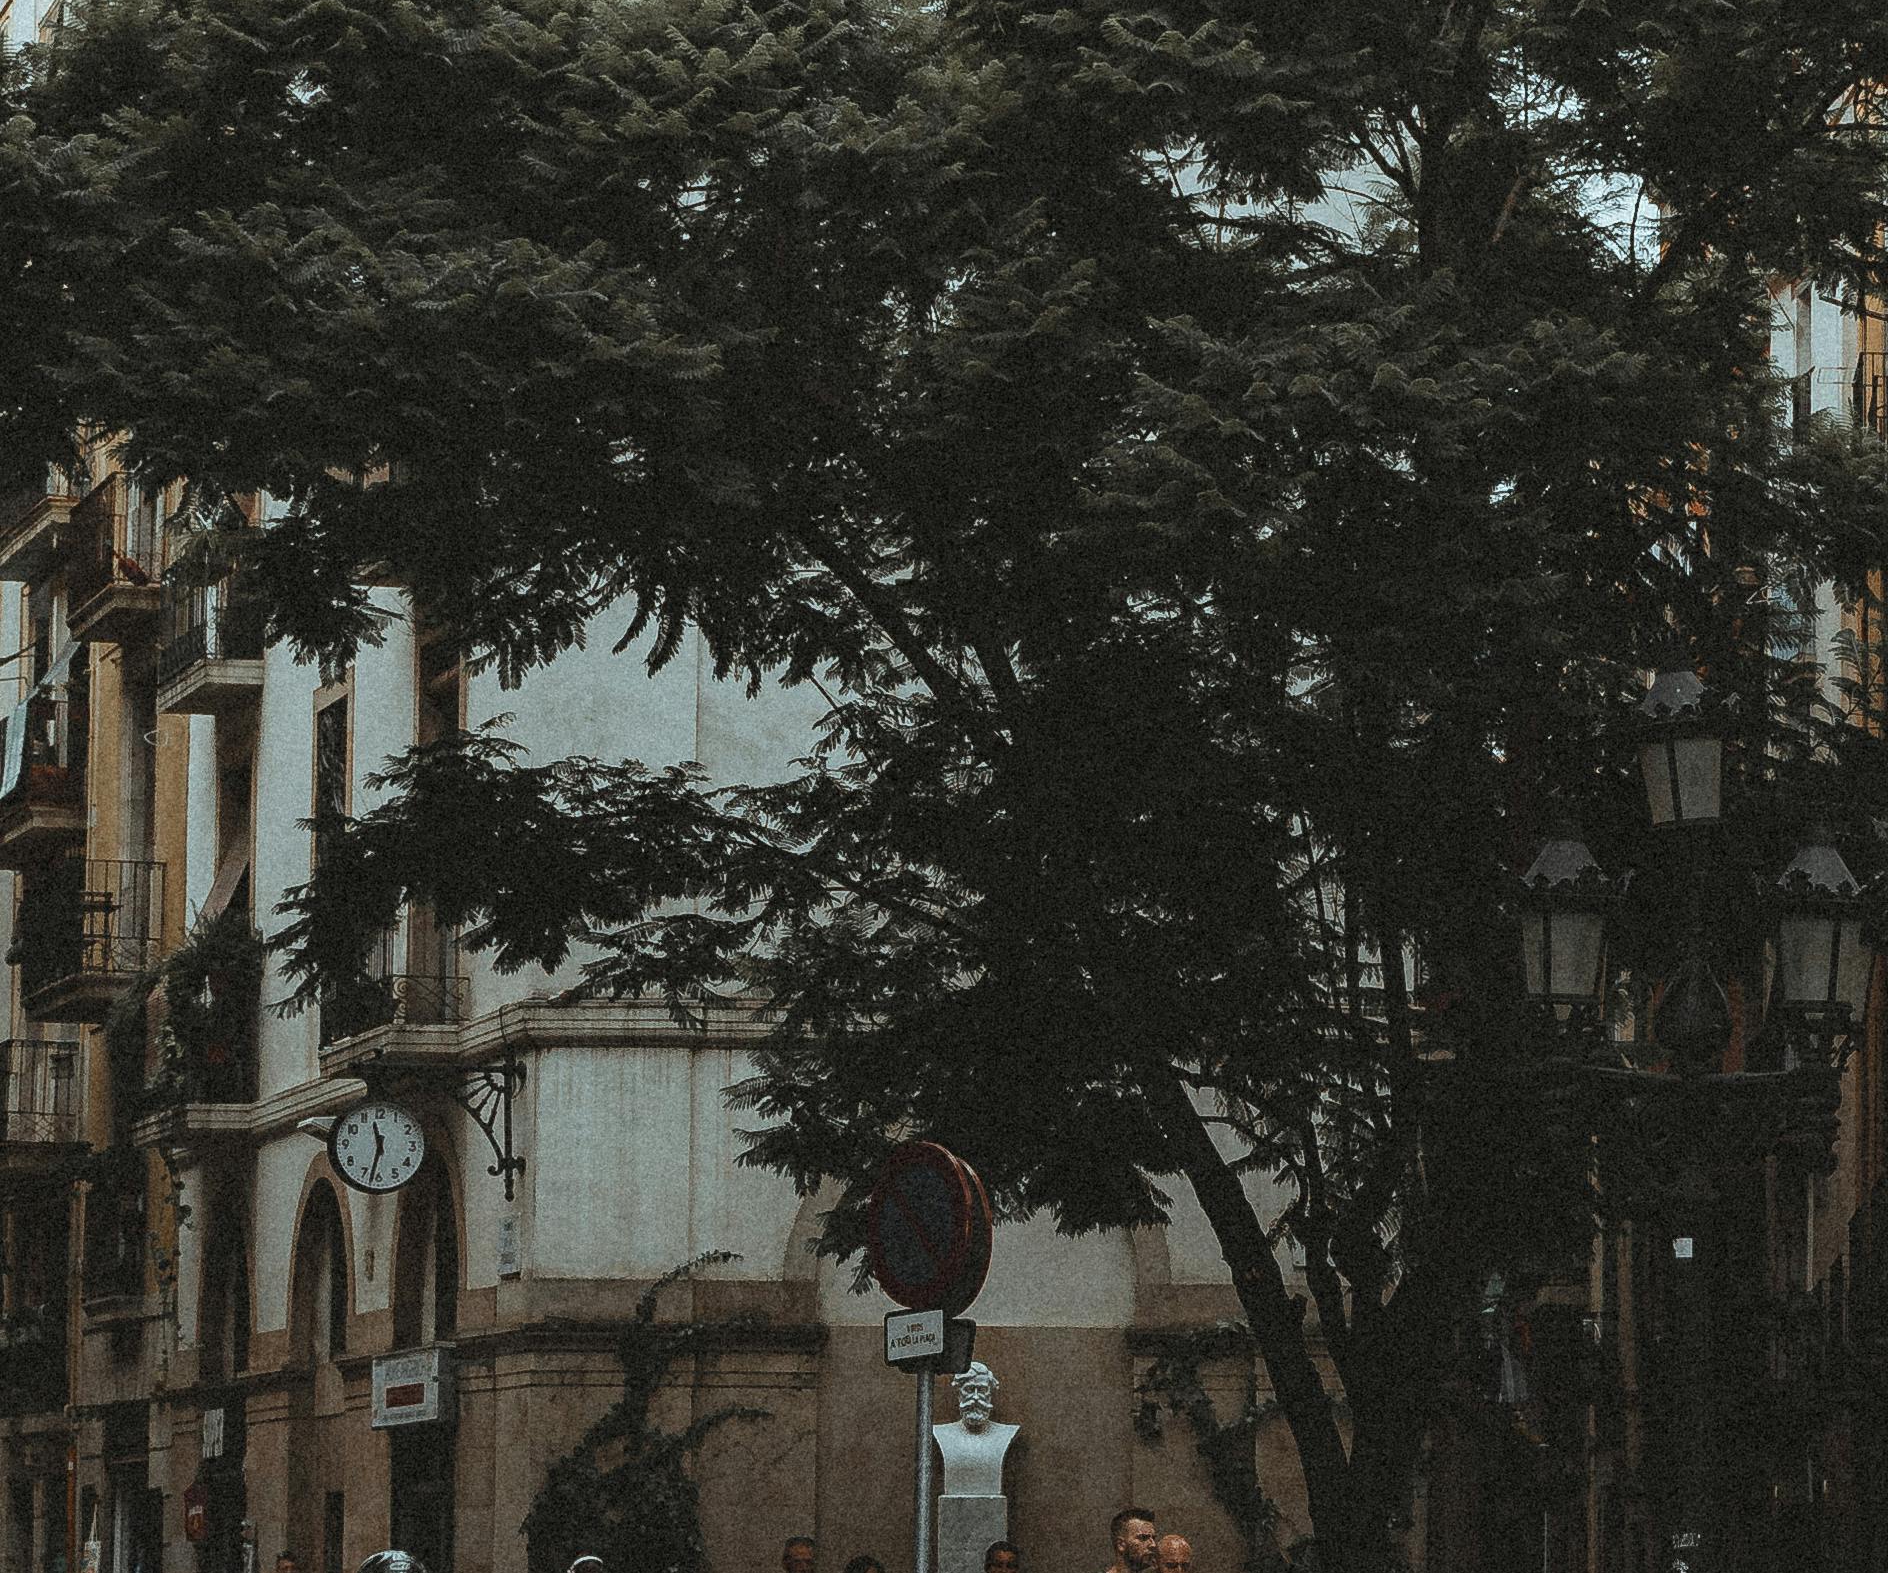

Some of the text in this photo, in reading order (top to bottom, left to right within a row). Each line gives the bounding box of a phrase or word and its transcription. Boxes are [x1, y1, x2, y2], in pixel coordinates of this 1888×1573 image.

[375, 1108, 386, 1119] 12
[348, 1124, 358, 1135] 10
[404, 1124, 412, 1135] 2
[408, 1141, 416, 1152] 3
[347, 1156, 354, 1167] 8
[402, 1157, 411, 1167] 4
[361, 1167, 368, 1179] 7
[375, 1173, 383, 1183] 6
[391, 1168, 399, 1179] 5
